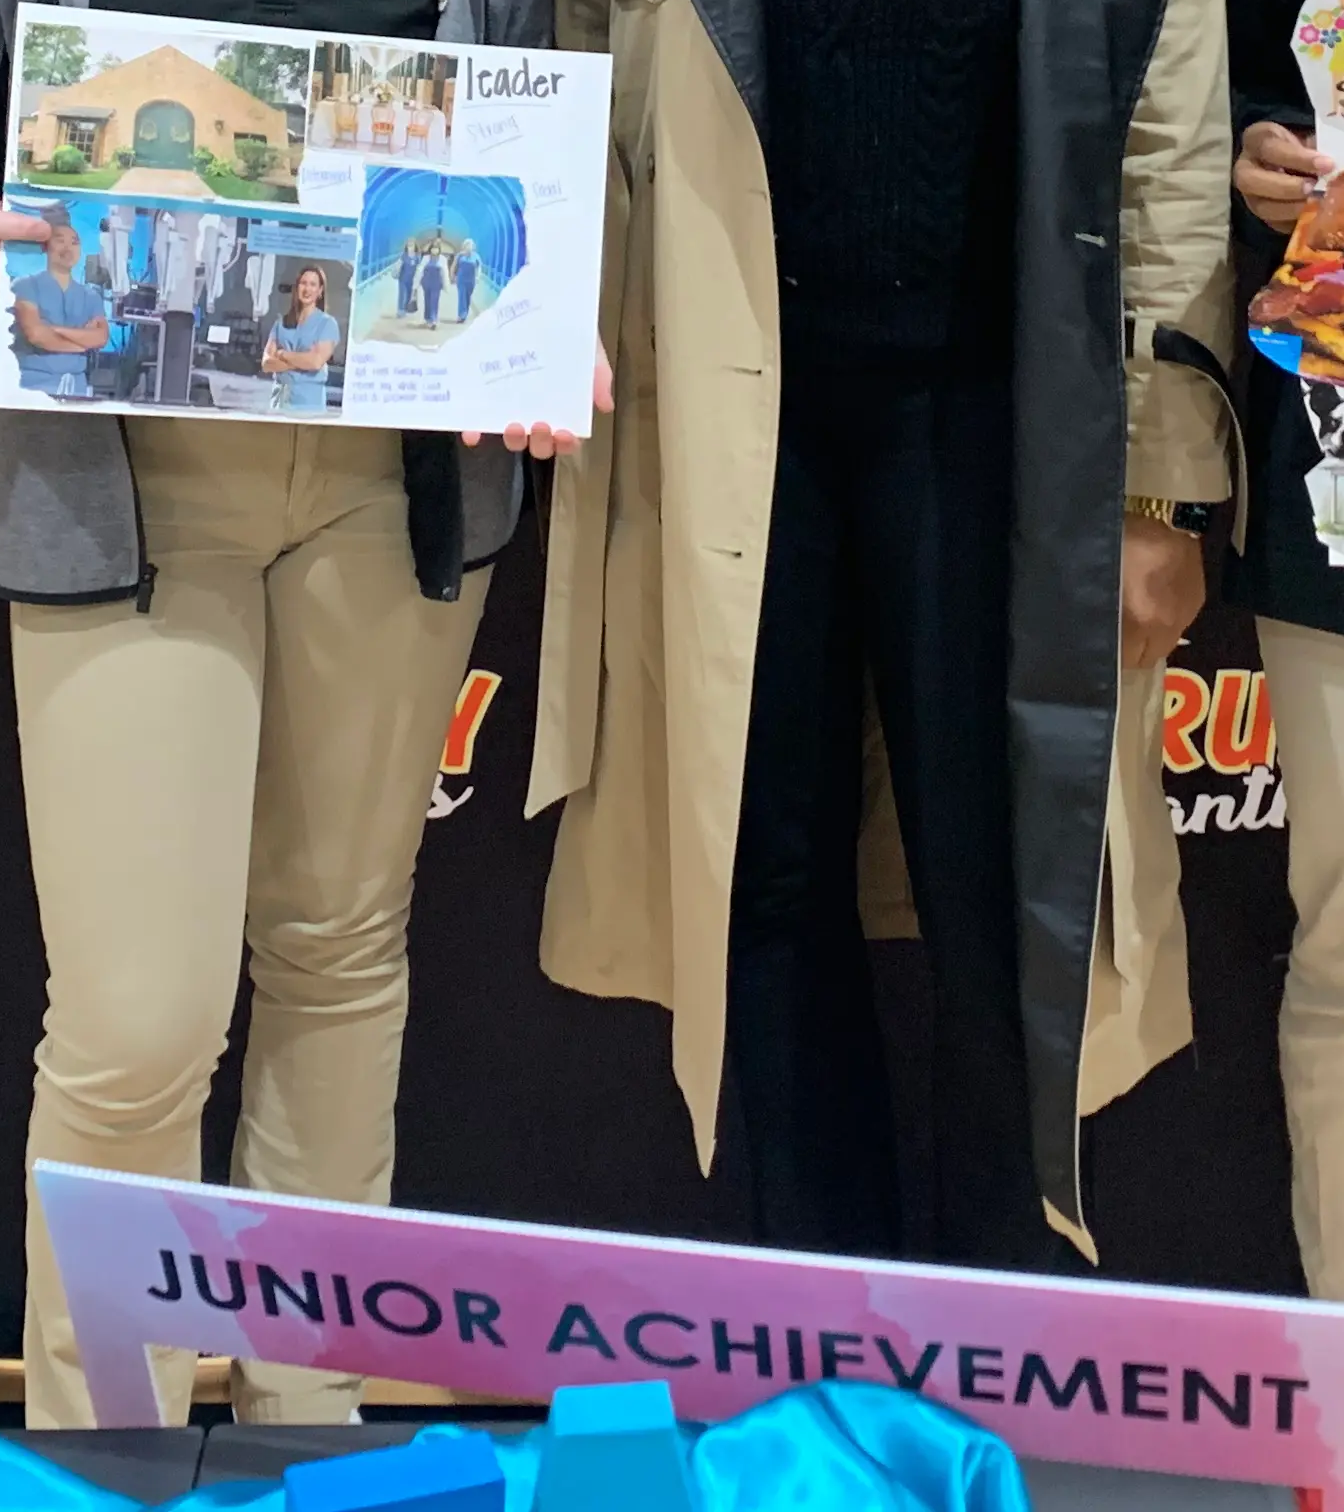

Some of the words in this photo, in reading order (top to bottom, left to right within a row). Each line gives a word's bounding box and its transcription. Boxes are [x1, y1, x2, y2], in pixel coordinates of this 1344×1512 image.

[467, 56, 566, 101] leader
[147, 1249, 506, 1348] JUNIOR
[546, 1302, 1309, 1435] ACHIEVEMENT
